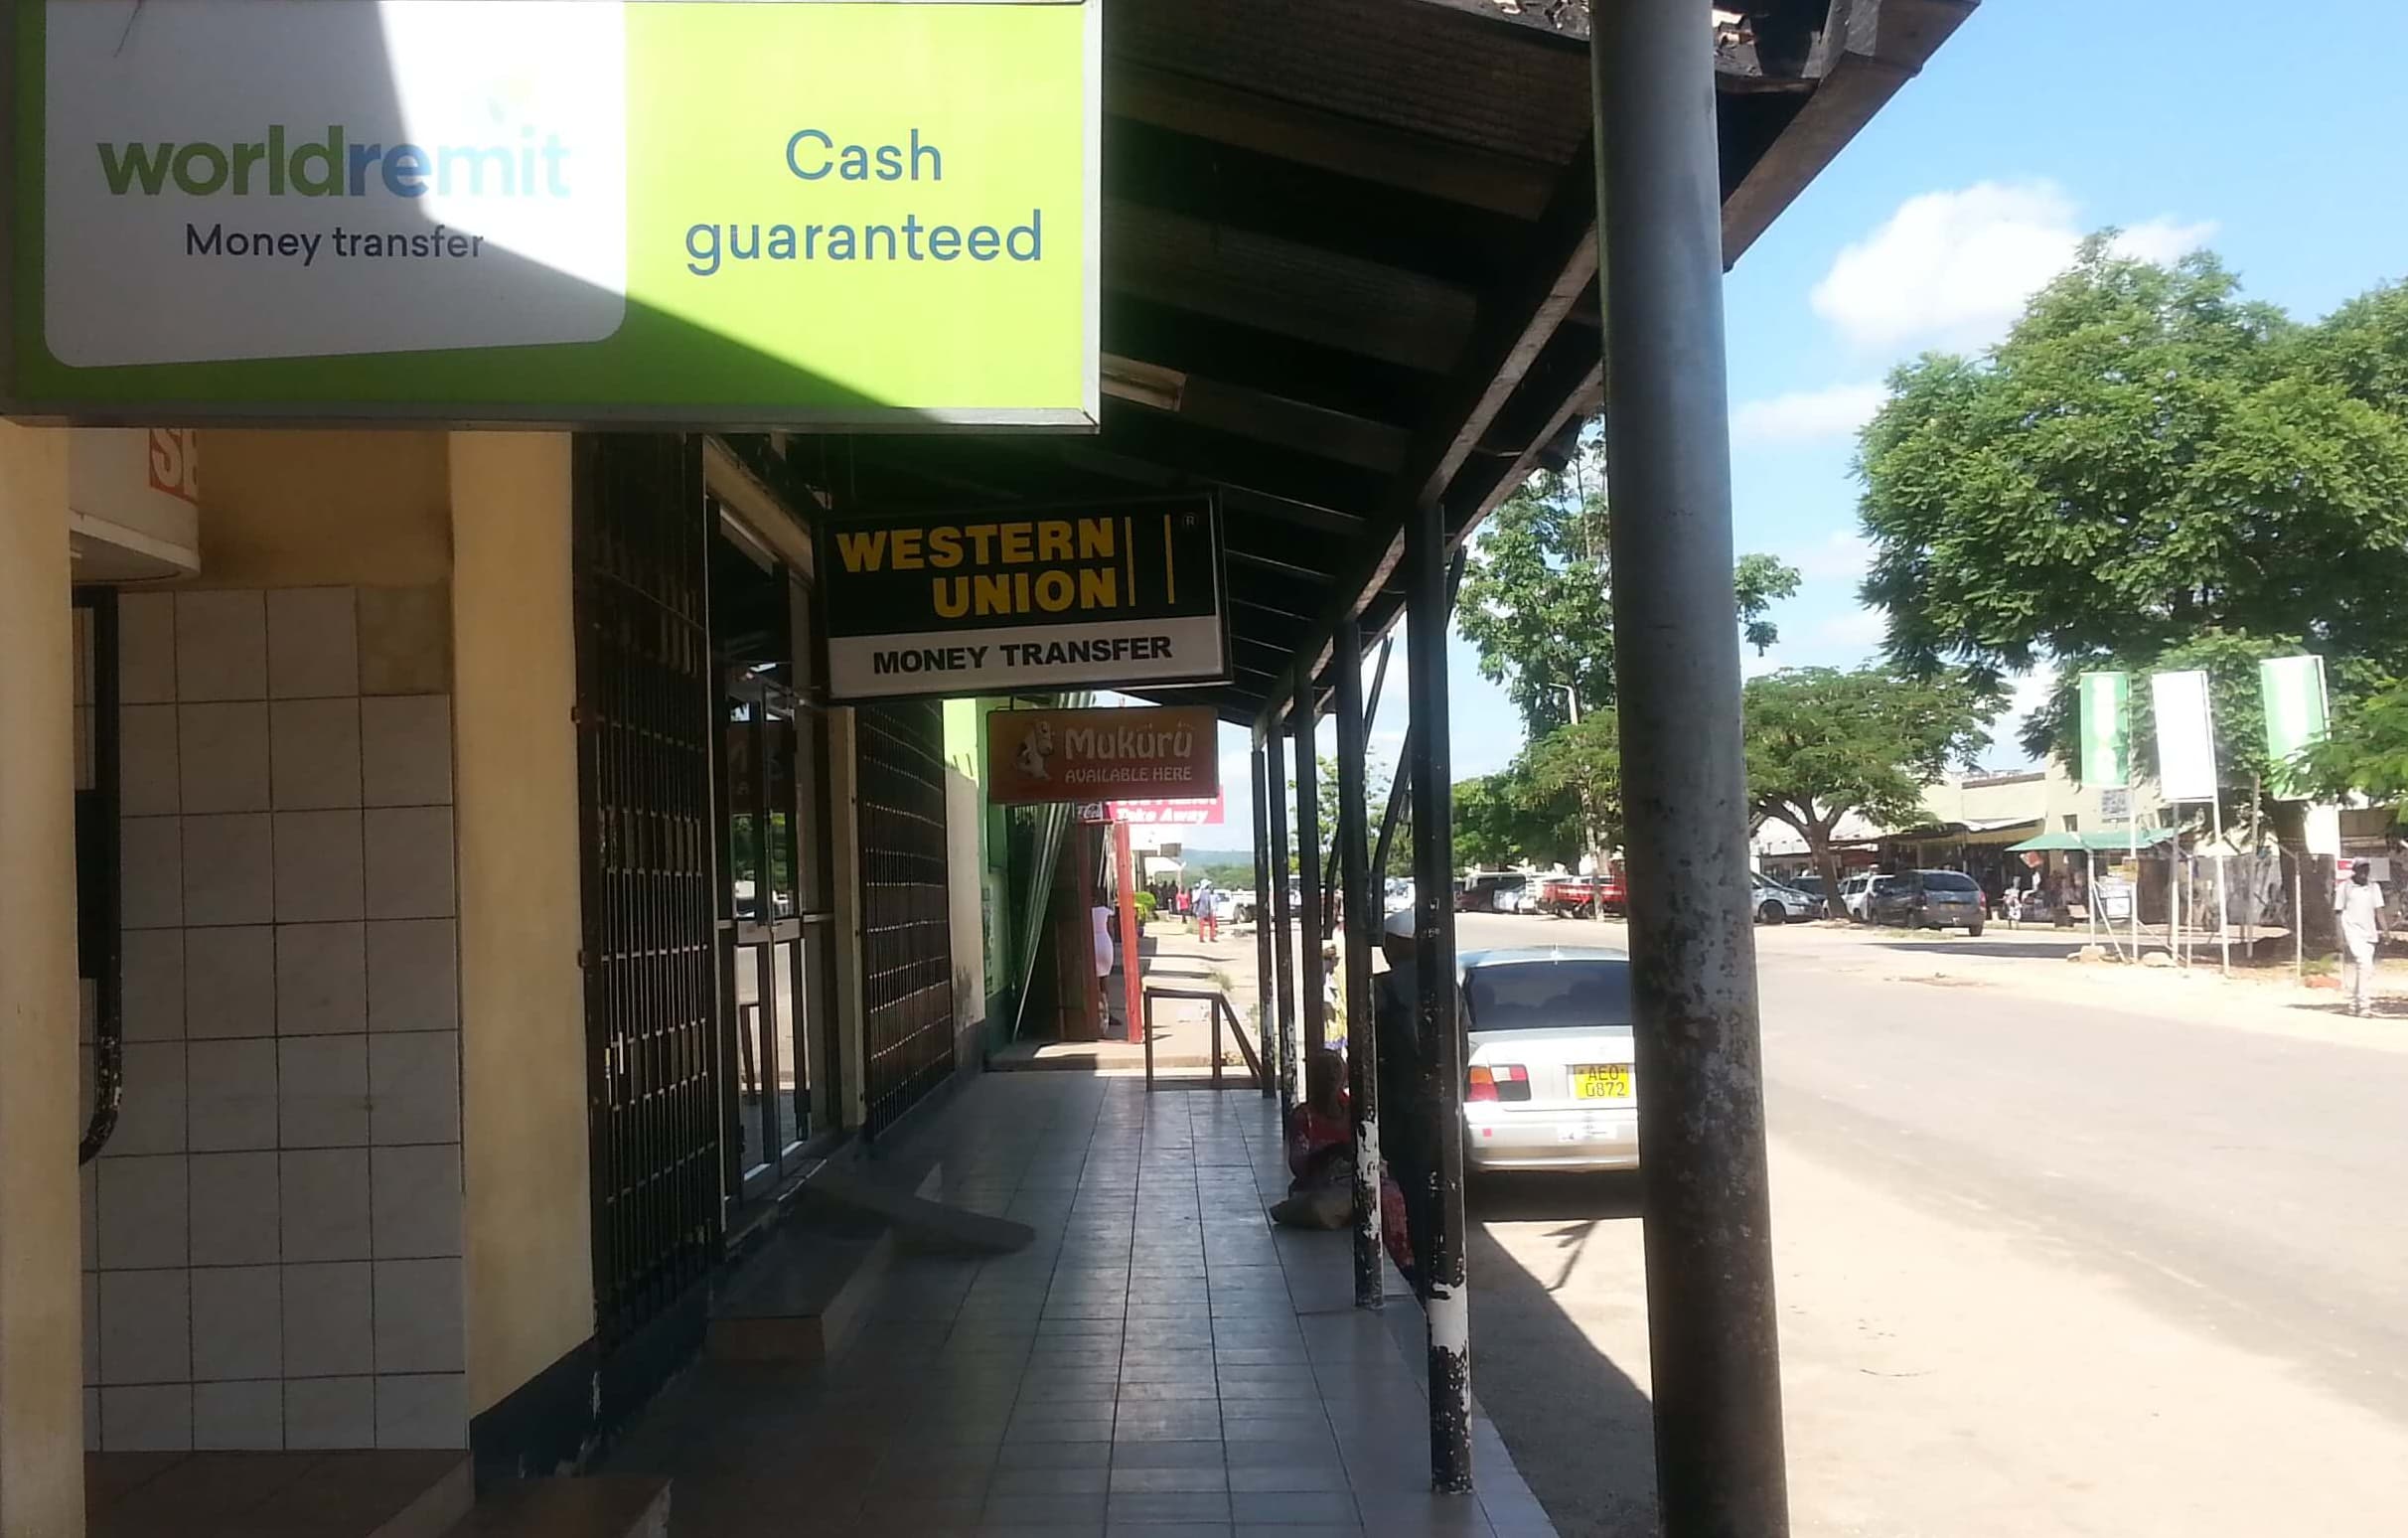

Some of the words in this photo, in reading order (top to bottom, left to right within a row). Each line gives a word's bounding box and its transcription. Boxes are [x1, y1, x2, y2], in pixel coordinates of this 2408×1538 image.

[96, 124, 573, 198] worldremit
[786, 128, 942, 181] Cash
[185, 224, 322, 267] Money
[332, 225, 485, 258] transfer
[685, 209, 1042, 276] guaranteed
[835, 517, 1116, 573] WESTERN
[932, 566, 1118, 619] UNION
[872, 645, 989, 676] MONEY
[998, 635, 1174, 668] TRANSFER
[1064, 767, 1149, 784] AVAILABLE
[1152, 765, 1193, 782] HERE
[1117, 808, 1157, 824] Take
[1159, 808, 1209, 826] Away
